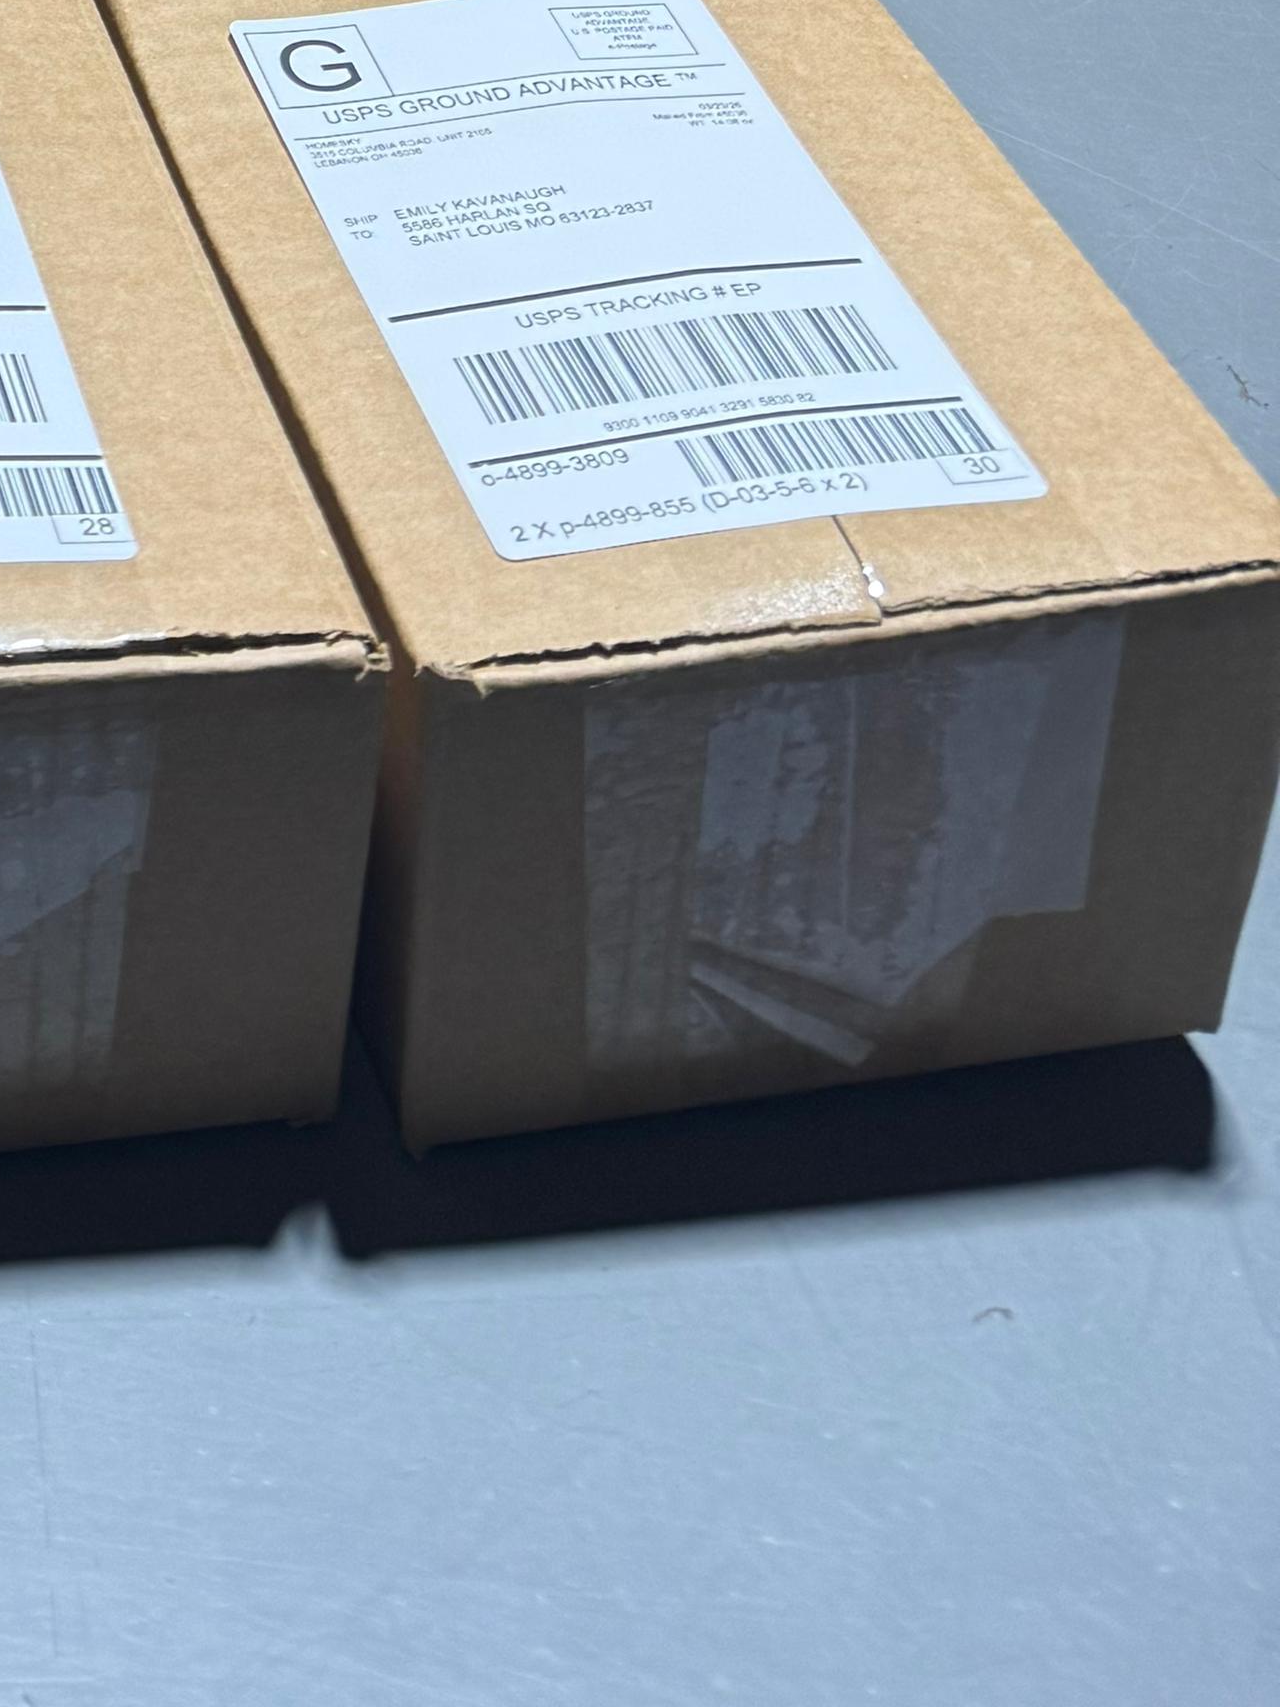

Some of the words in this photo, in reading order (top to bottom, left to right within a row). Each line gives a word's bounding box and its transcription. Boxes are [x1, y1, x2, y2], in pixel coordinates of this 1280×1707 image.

[279, 39, 362, 92] G
[322, 103, 393, 126] USPS
[399, 86, 511, 115] GROUND
[518, 73, 672, 99] ADVANTAGE
[343, 213, 379, 228] SHIP
[393, 201, 448, 221] EMILY
[451, 184, 568, 211] KAVANAUGH
[349, 229, 374, 240] TO
[401, 217, 442, 234] 5586
[446, 206, 521, 227] HARLAN
[523, 201, 552, 215] SQ
[408, 229, 462, 247] SAINT
[467, 220, 523, 238] LOUIS
[525, 215, 556, 230] MO
[514, 306, 582, 329] USPS
[583, 286, 708, 317] TRACKING
[712, 284, 727, 298] #
[730, 282, 762, 297] EP
[603, 418, 640, 433] 9300
[643, 410, 679, 426] 1109
[680, 403, 716, 419] 9041
[719, 397, 755, 413] 3291
[481, 448, 630, 487] o-4899-3809
[963, 456, 1001, 475] 30
[79, 517, 115, 536] 28
[509, 525, 530, 543] 2
[531, 521, 557, 539] X
[558, 497, 697, 541] p-4899-855
[701, 476, 817, 514] (D-03-5-6
[823, 479, 838, 492] x
[839, 472, 869, 492] 2)
